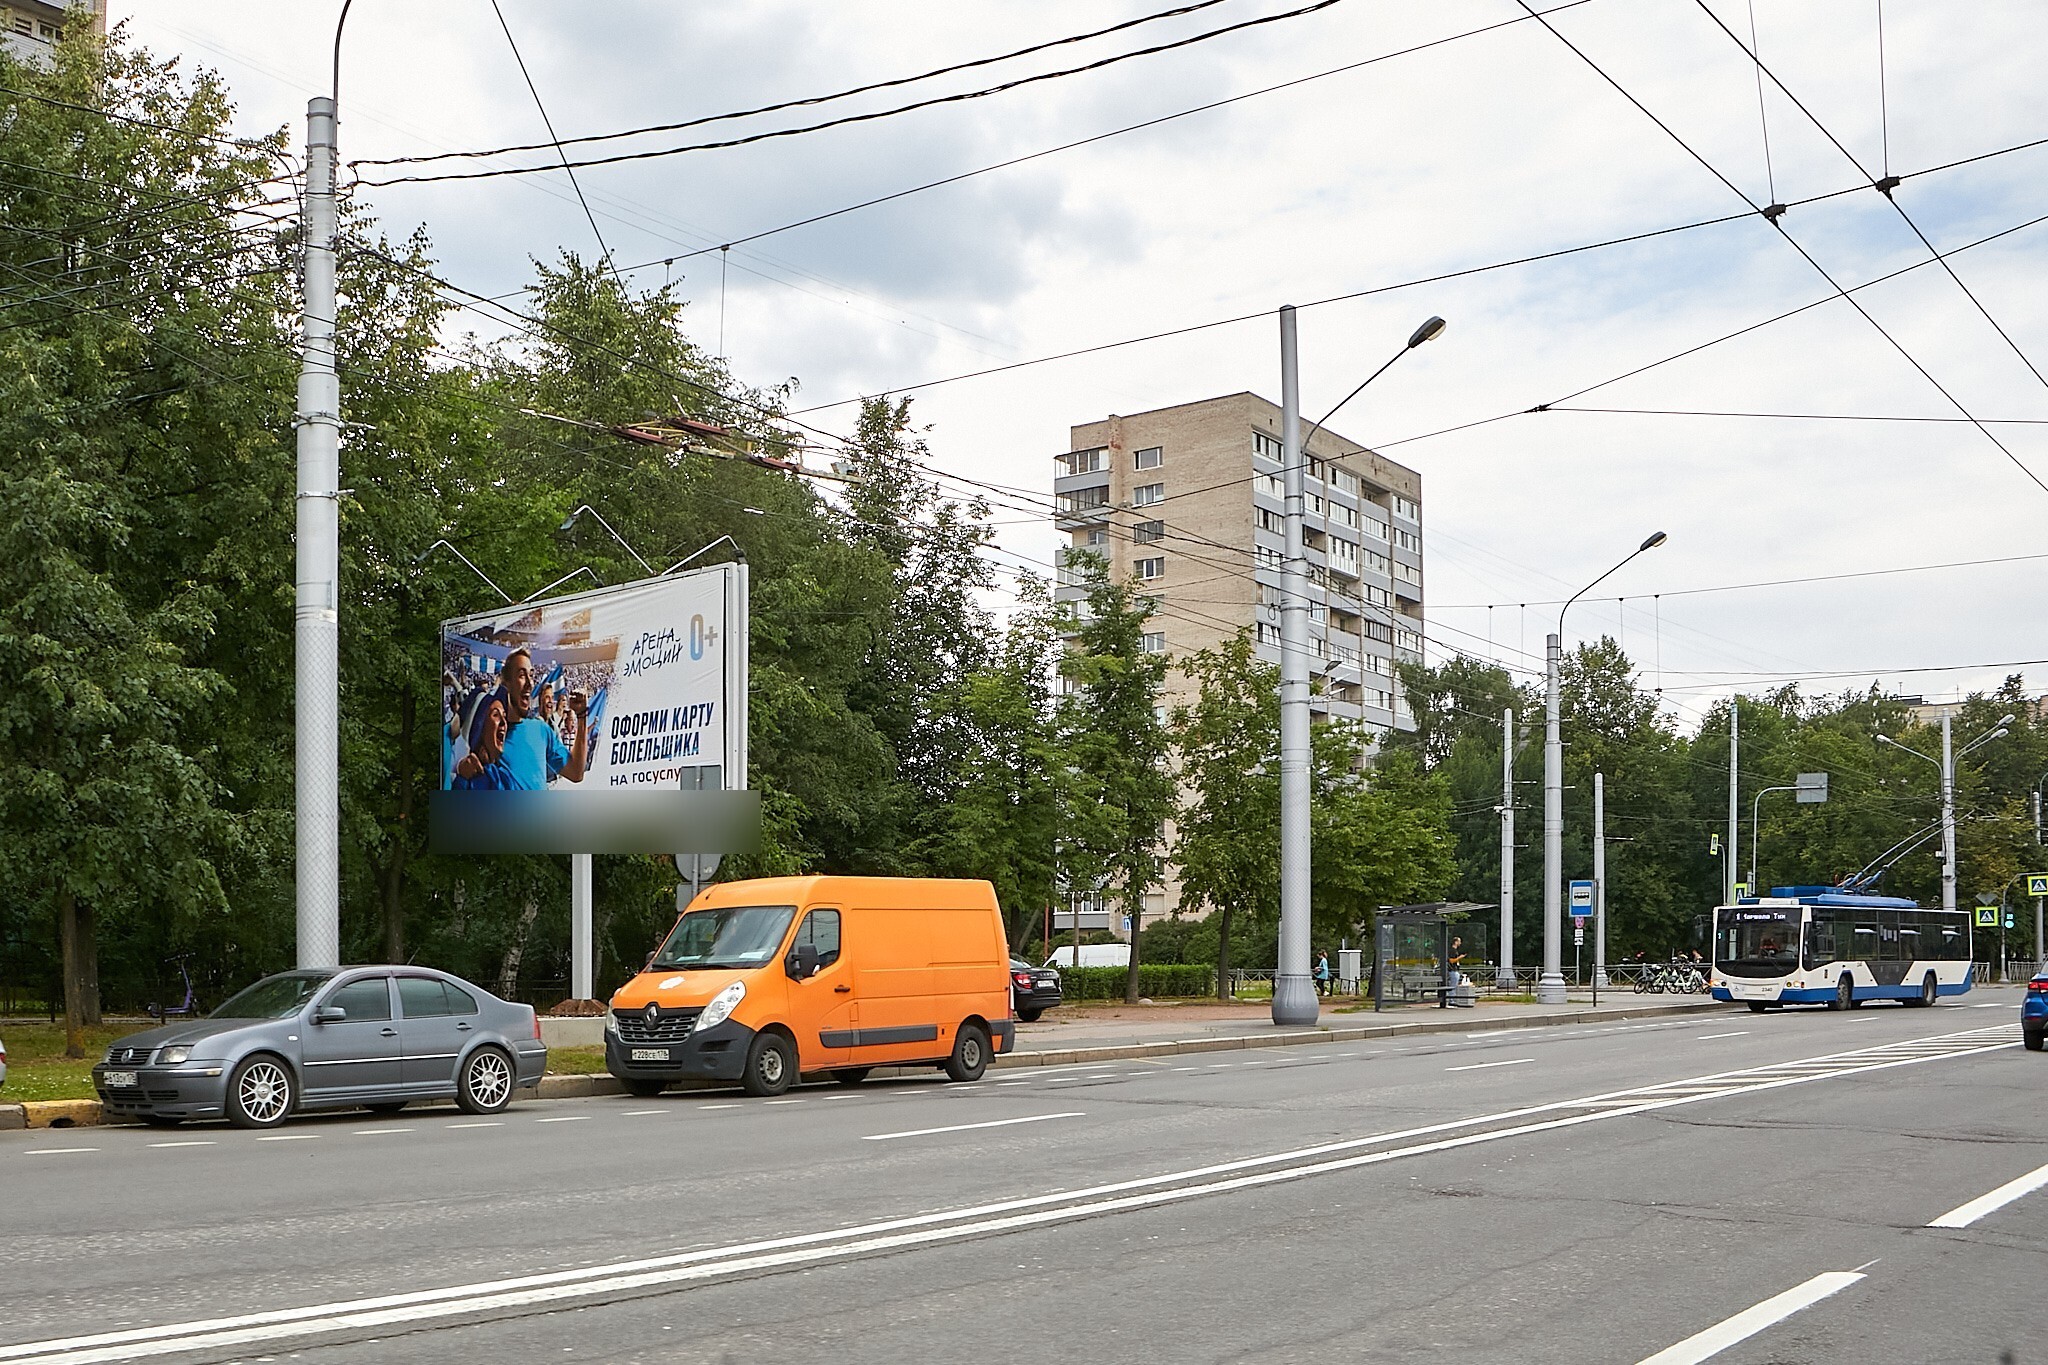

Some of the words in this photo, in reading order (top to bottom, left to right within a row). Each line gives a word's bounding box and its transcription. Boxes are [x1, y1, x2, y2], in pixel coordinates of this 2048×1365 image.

[631, 627, 675, 655] АРЕНА
[690, 613, 718, 661] 0+
[623, 637, 683, 677] ЭМОЦИЙ
[611, 709, 669, 739] ОФОРМИ
[671, 702, 715, 731] КАРТУ
[610, 731, 700, 766] БОЛЕЛЬЩИКА
[632, 767, 682, 785] госуслу
